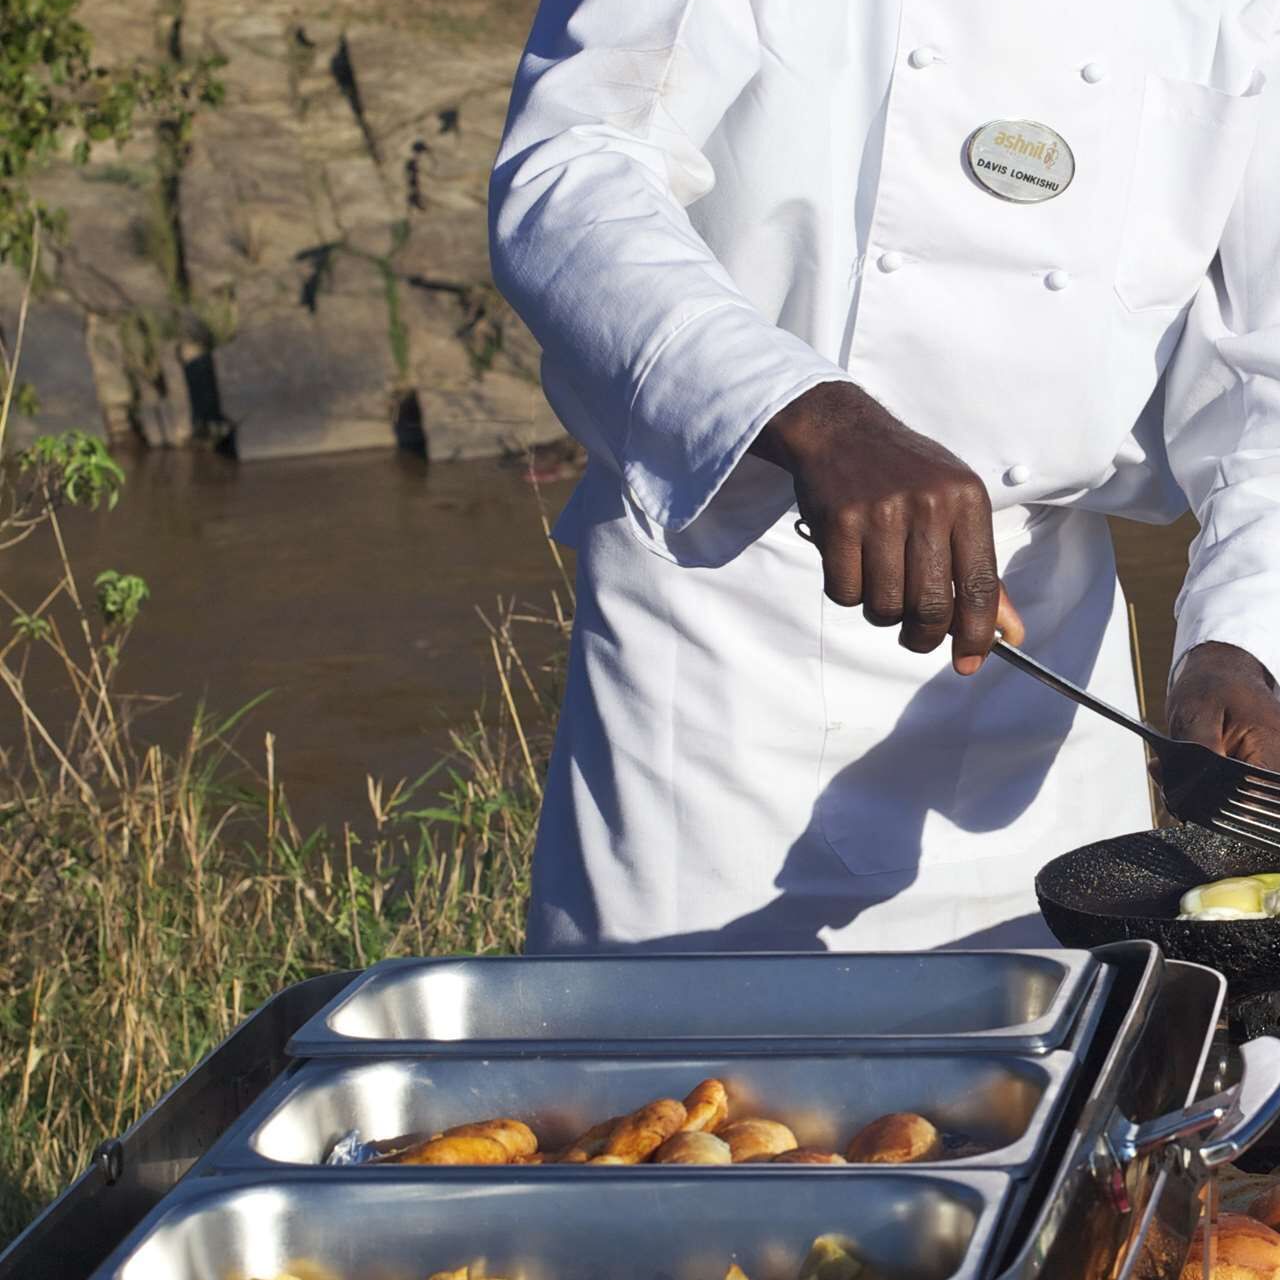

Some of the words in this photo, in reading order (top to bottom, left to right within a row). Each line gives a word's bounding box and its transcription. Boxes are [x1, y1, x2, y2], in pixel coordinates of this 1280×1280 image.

[994, 131, 1046, 161] ashnil
[976, 158, 1008, 175] DAVIS
[1010, 168, 1060, 192] LONKISHU
